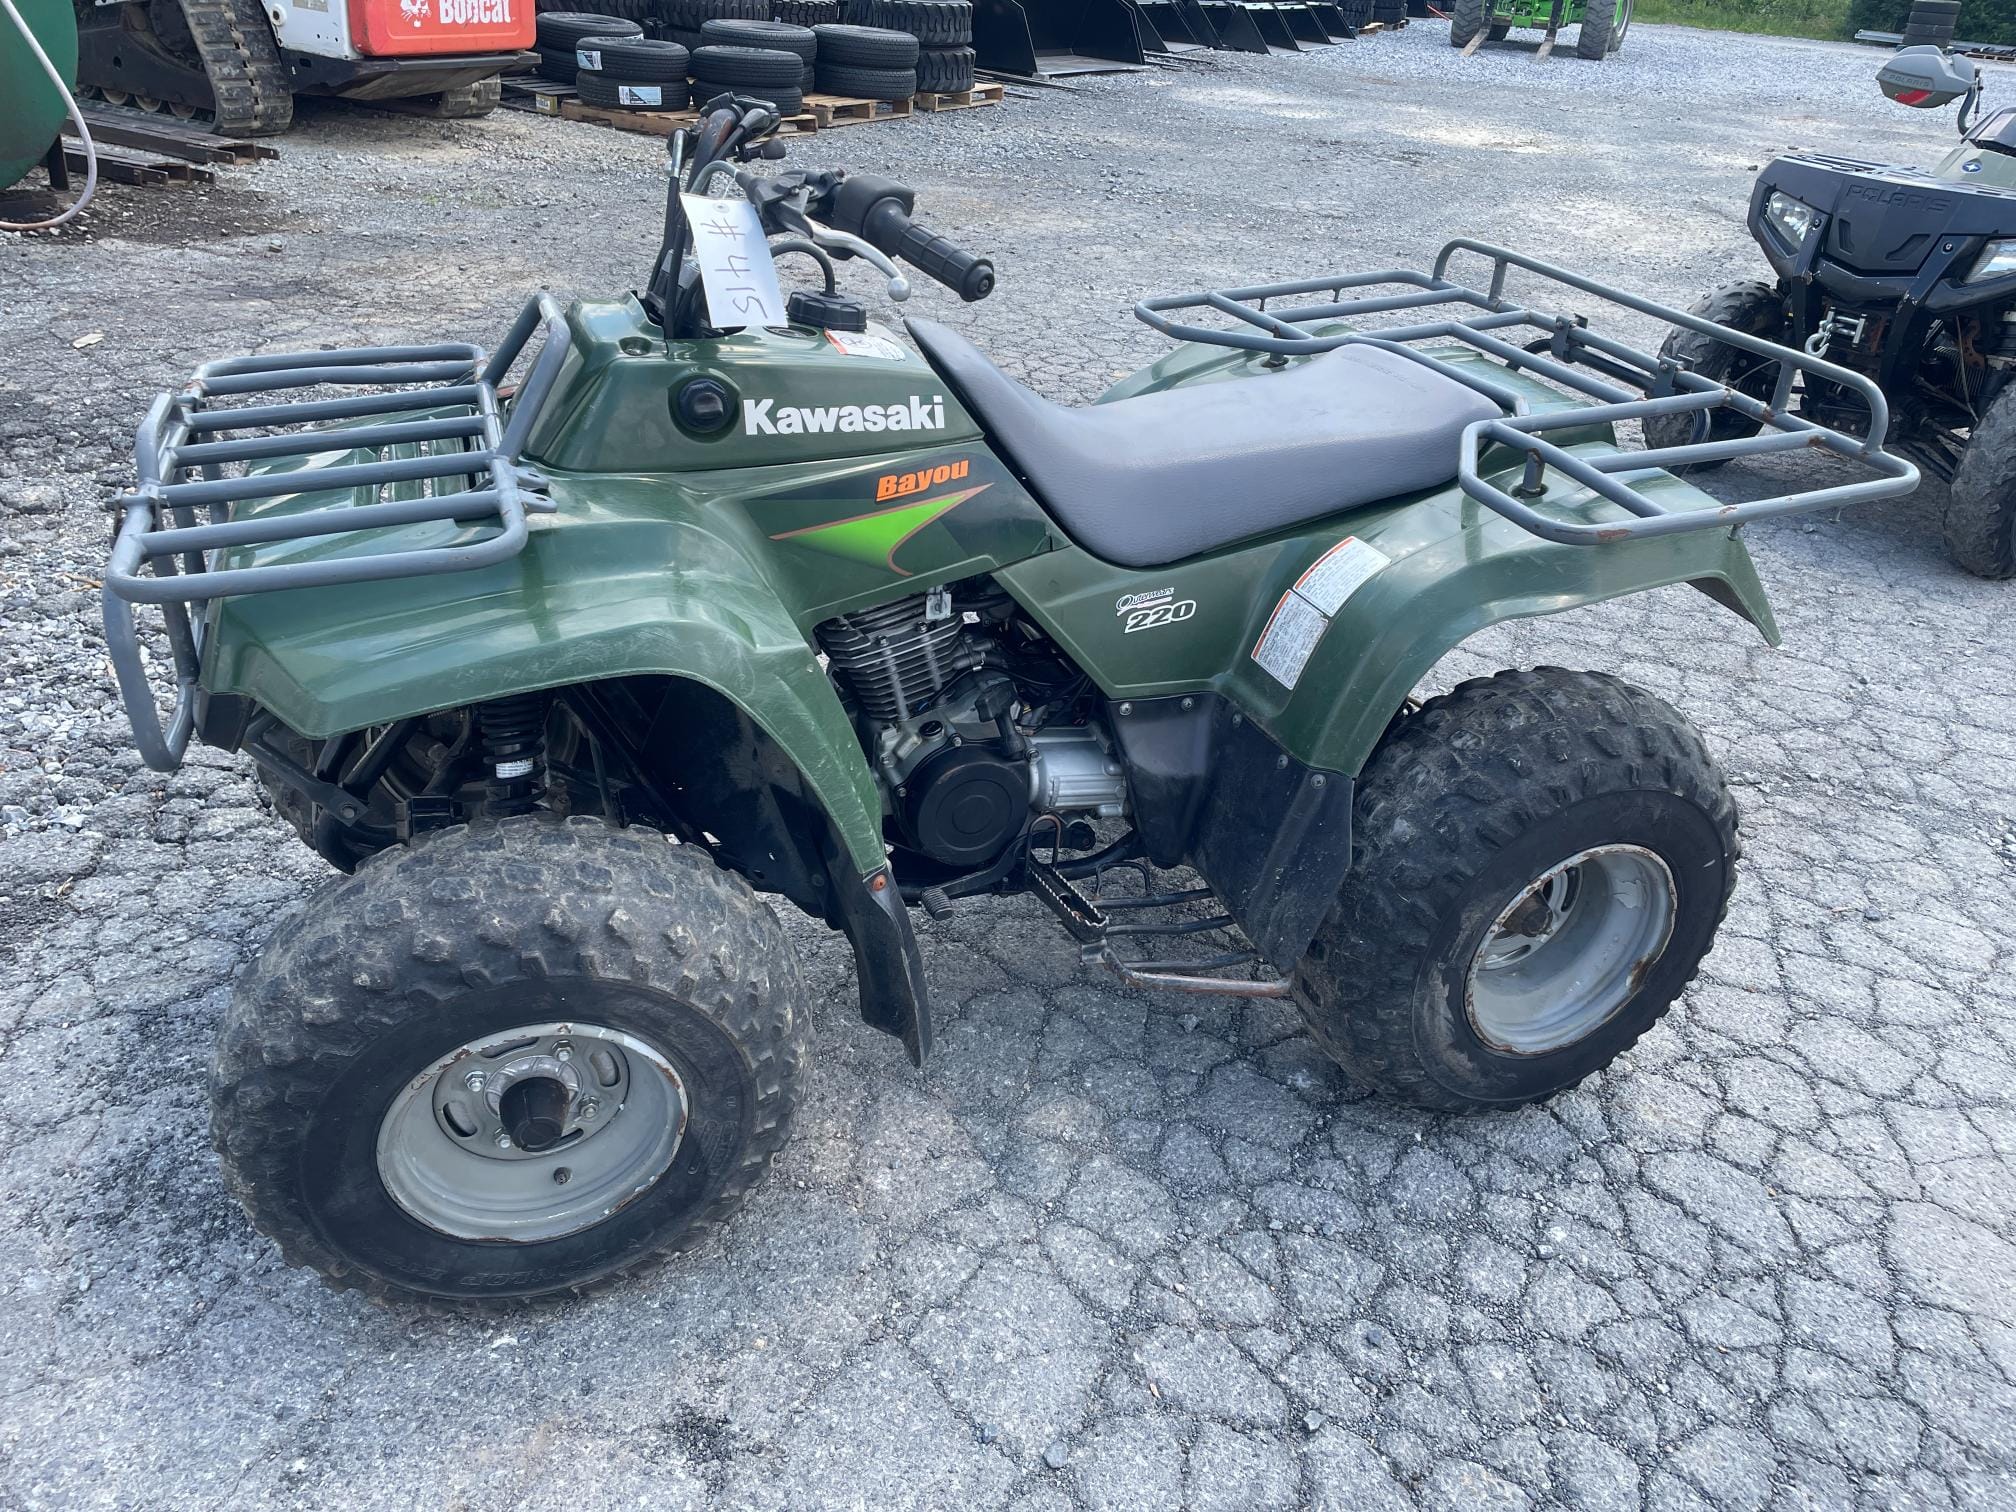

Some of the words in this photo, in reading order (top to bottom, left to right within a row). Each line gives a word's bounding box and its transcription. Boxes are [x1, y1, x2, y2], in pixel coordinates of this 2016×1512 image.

[439, 0, 511, 24] Bobcat
[1846, 184, 1952, 213] POLARIS
[743, 395, 945, 435] Kawasaki
[876, 459, 969, 501] Bayou
[1124, 600, 1197, 633] 220
